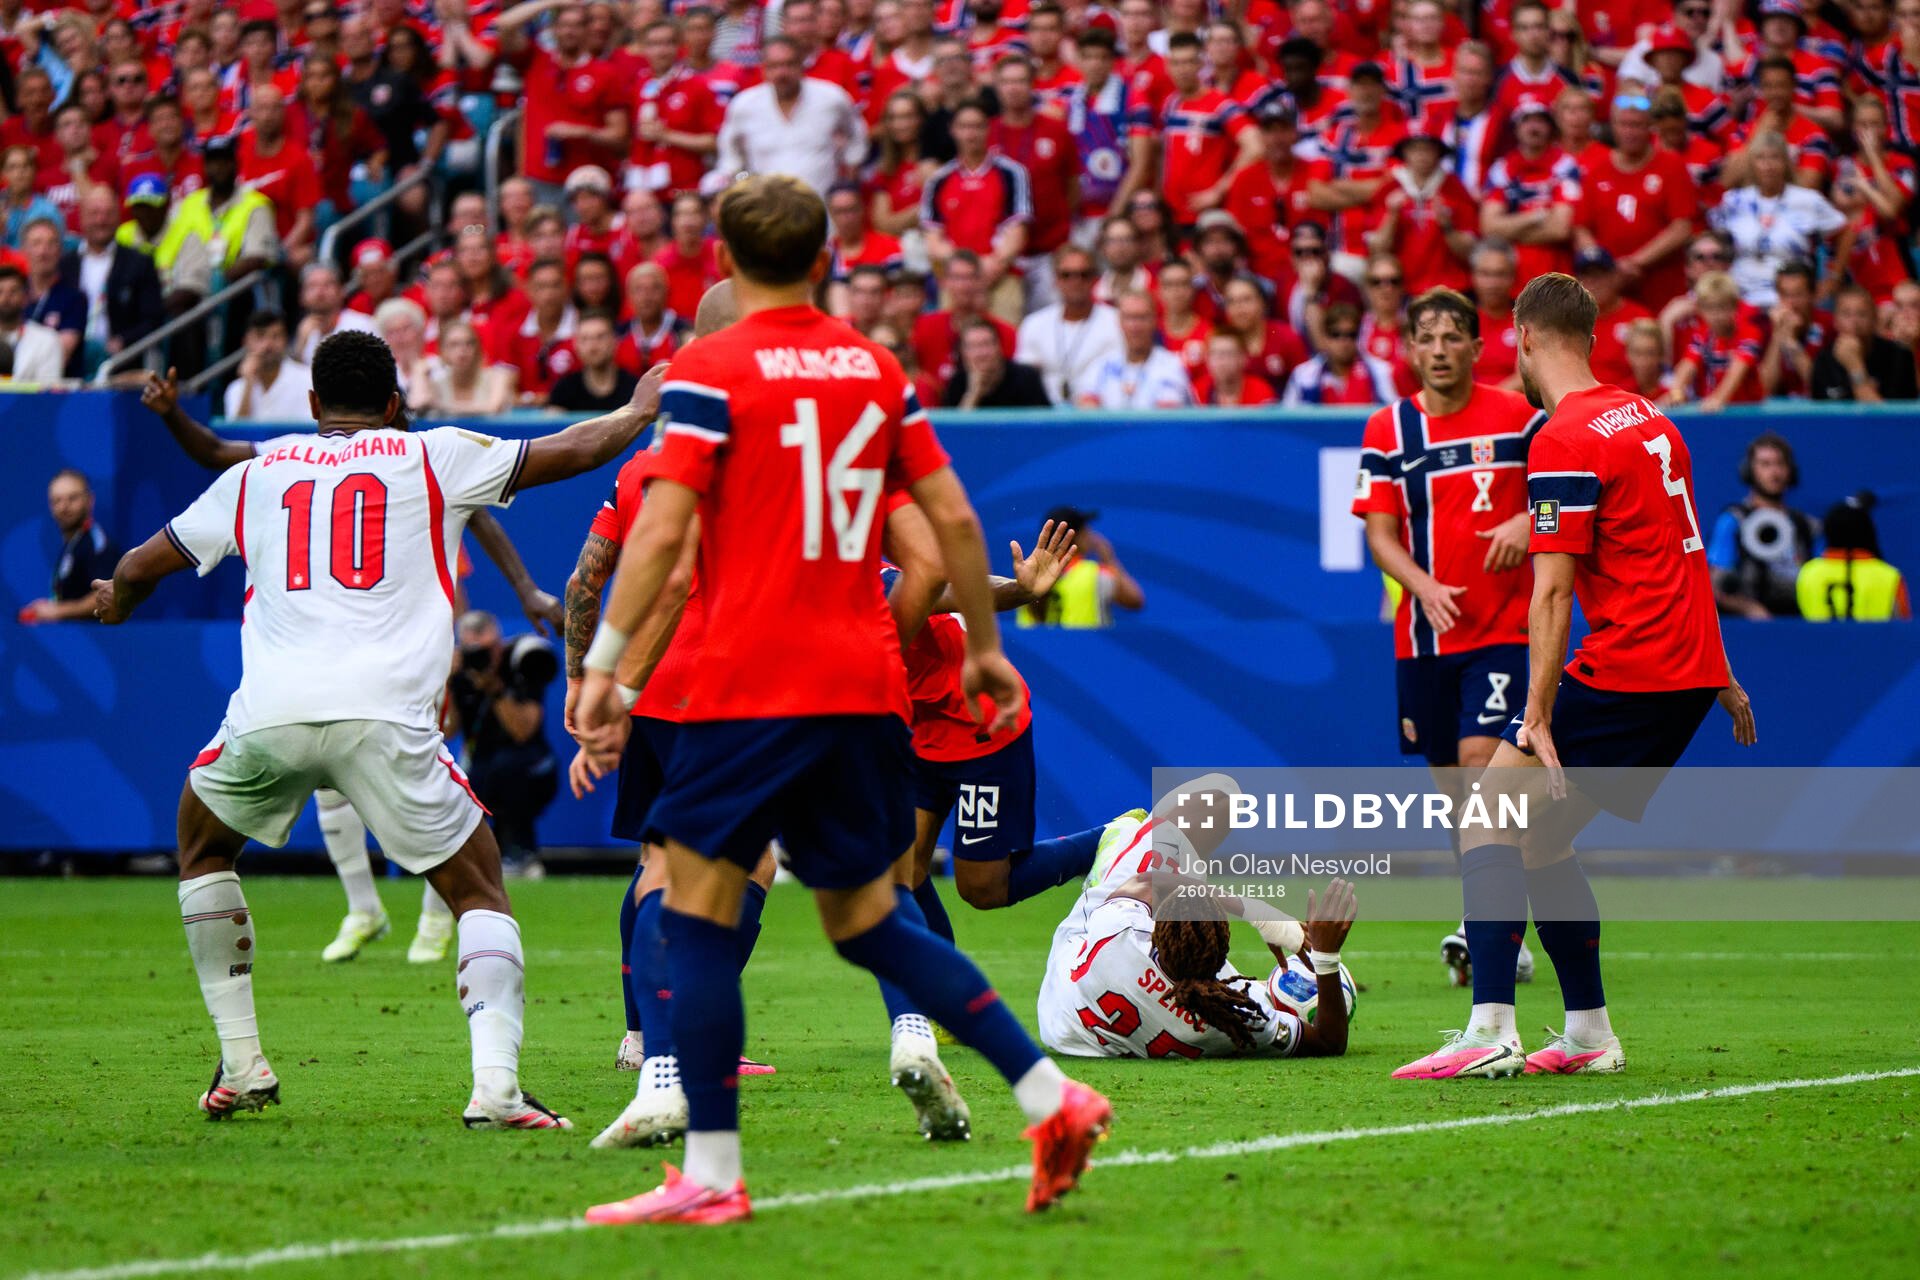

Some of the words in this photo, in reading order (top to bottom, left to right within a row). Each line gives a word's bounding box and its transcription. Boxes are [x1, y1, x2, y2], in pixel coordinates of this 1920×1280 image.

[263, 437, 407, 467] BELLINGHAM
[779, 397, 888, 562] 16
[1471, 471, 1495, 512] 8
[1642, 433, 1704, 553] 3
[281, 473, 388, 592] 10
[1485, 672, 1511, 711] 8
[958, 784, 1000, 828] 22
